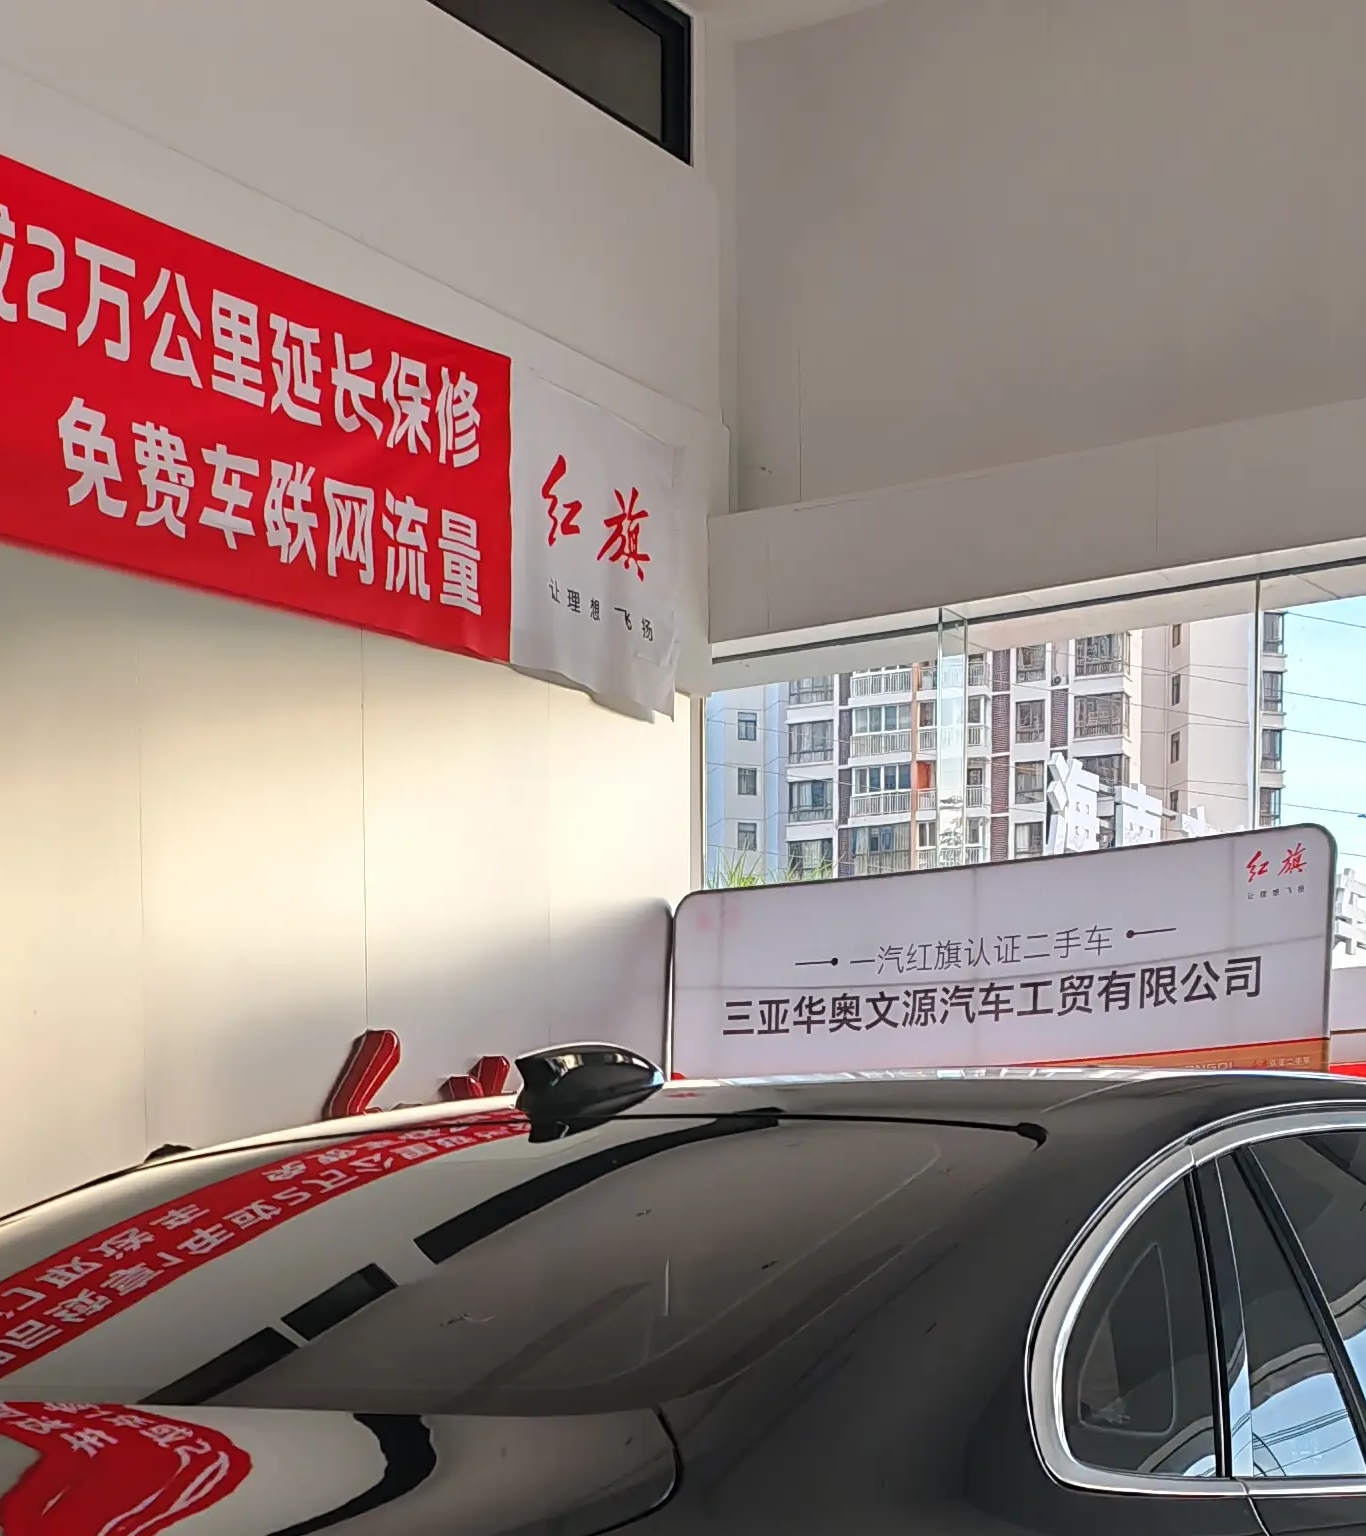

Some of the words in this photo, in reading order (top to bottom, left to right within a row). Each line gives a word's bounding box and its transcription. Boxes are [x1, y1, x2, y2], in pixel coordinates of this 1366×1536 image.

[57, 396, 482, 616] 免费车联网流量
[541, 454, 651, 582] 红旗
[549, 578, 654, 642] 让理想飞扬
[1246, 842, 1308, 883] 红旗
[849, 924, 1114, 975] 一汽红旗认证二手车
[722, 955, 1263, 1036] 三亚华奥文源汽车工贸有限公司
